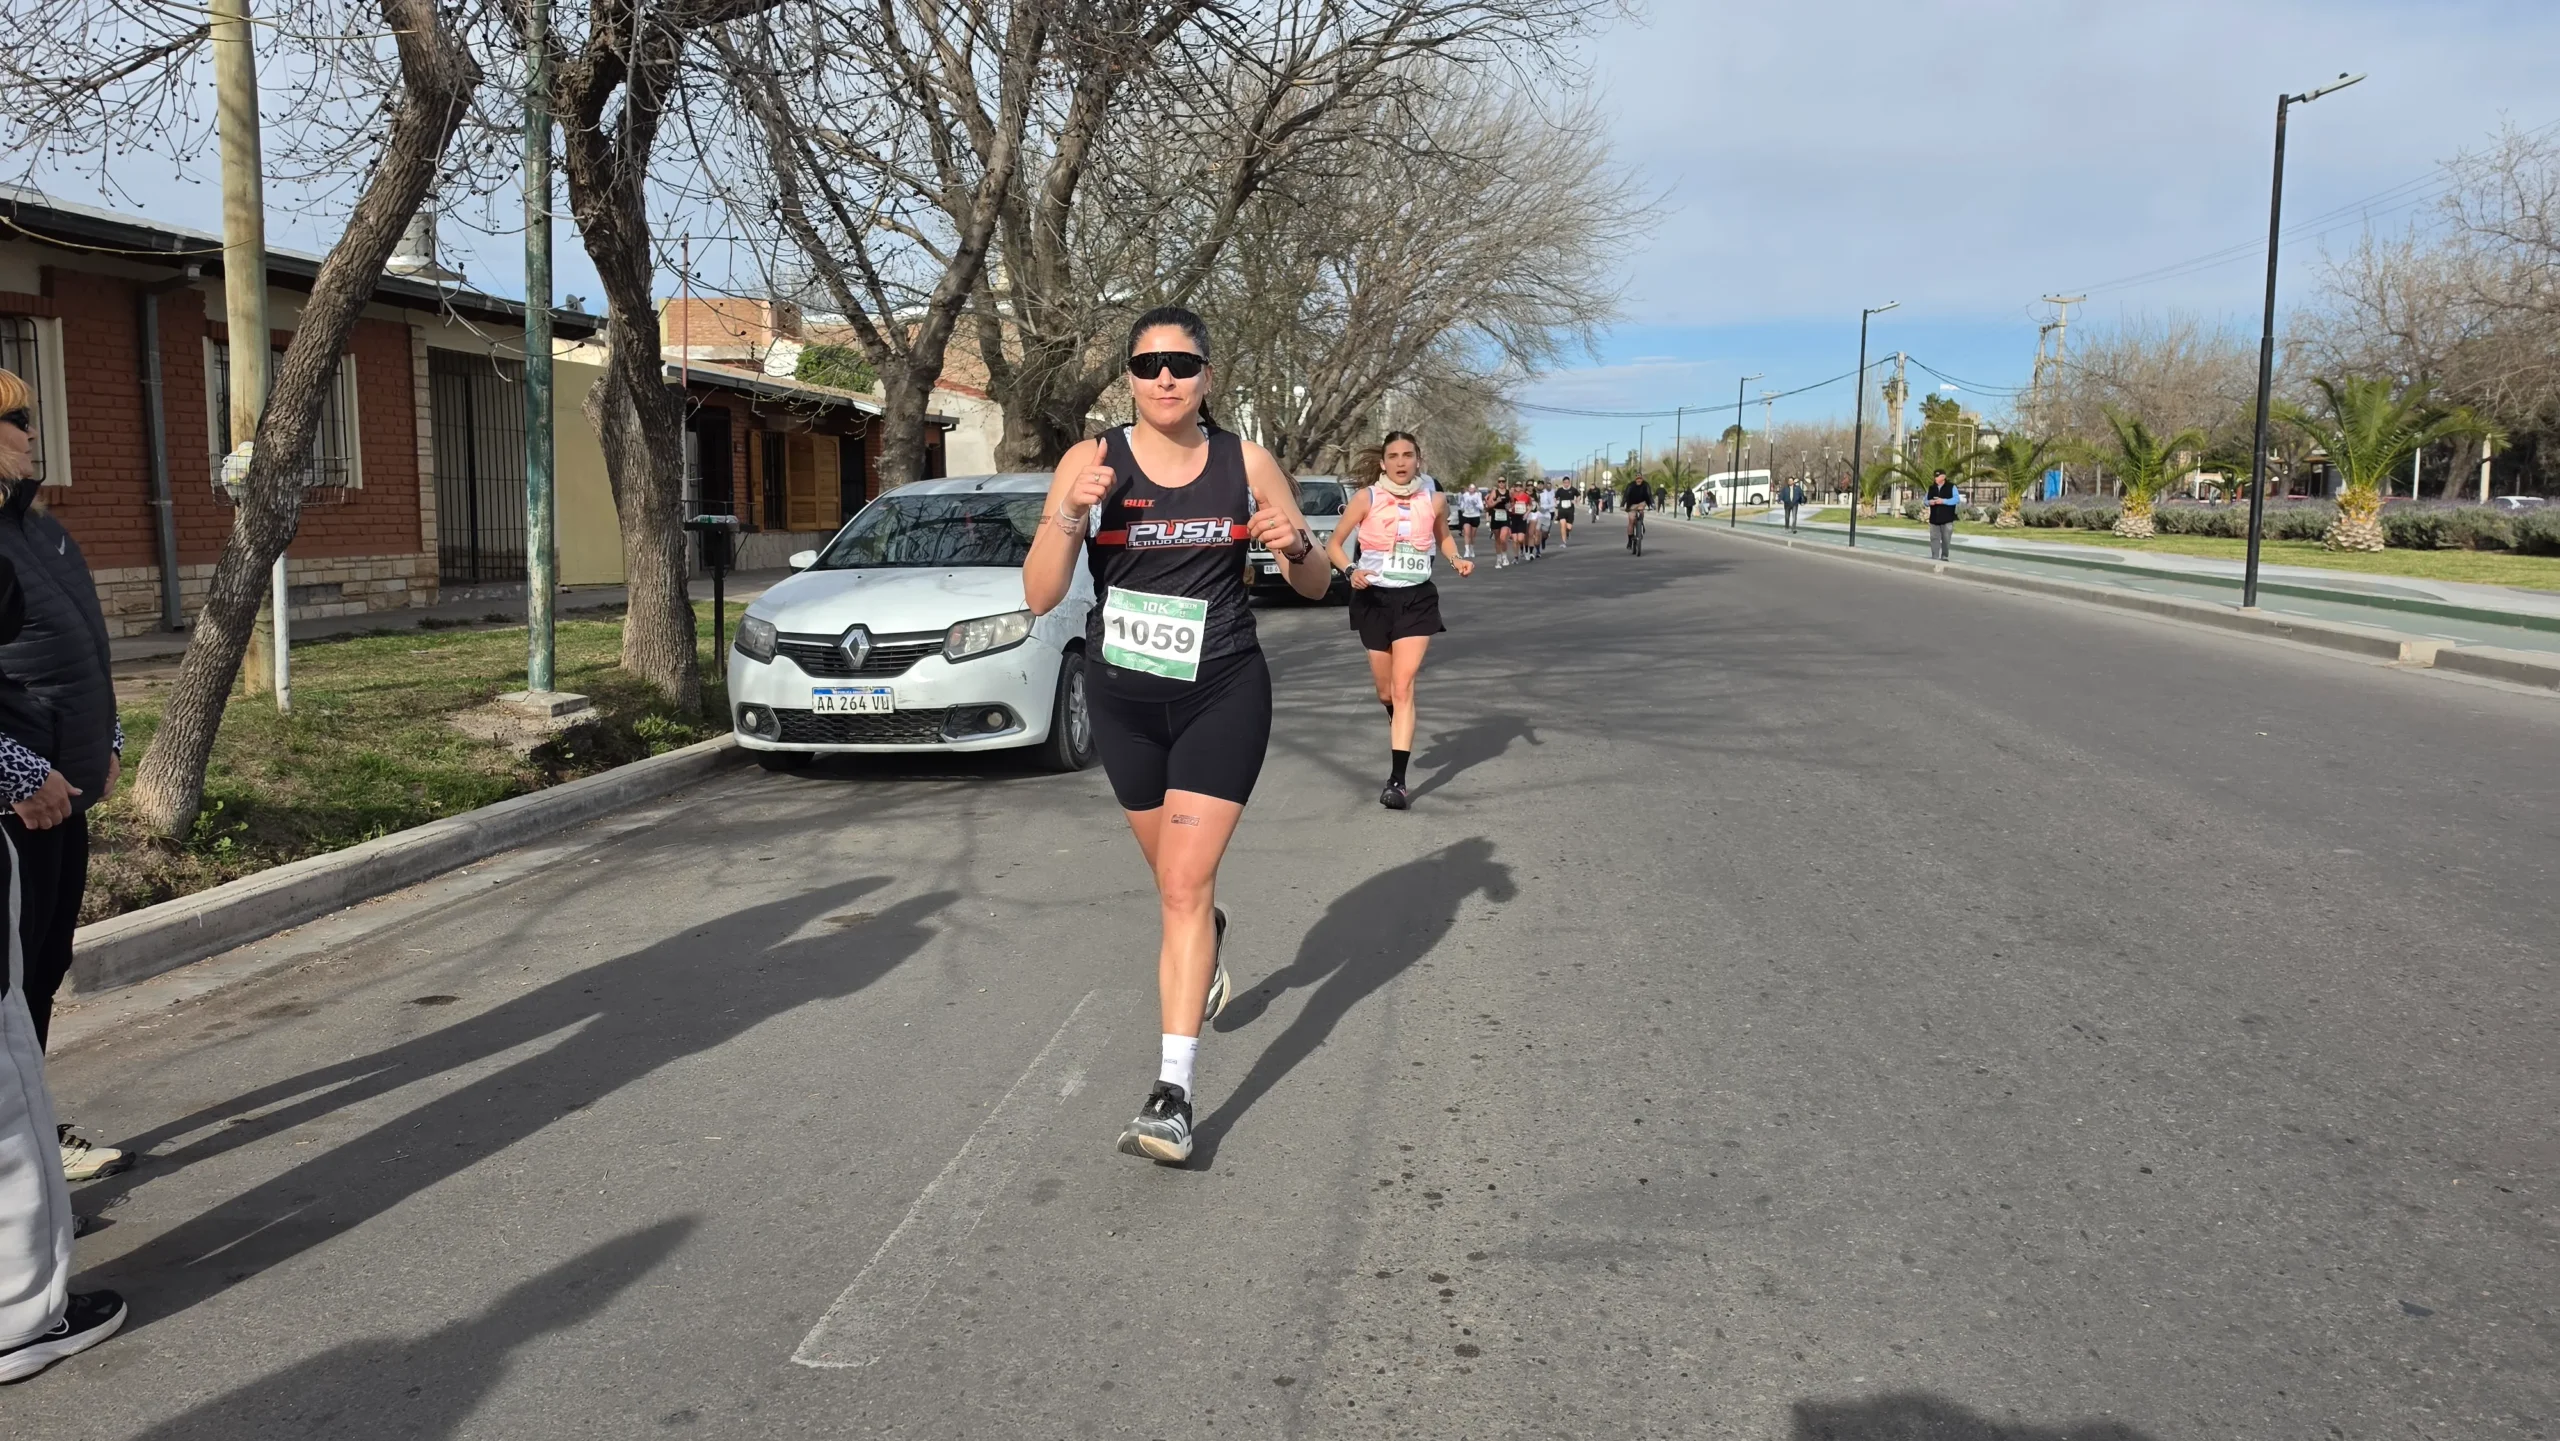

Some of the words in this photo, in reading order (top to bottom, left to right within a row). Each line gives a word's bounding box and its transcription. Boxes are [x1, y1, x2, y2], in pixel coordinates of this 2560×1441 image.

[1128, 520, 1231, 541] PUSH
[1174, 536, 1232, 545] DEPORTIVA
[1388, 555, 1425, 571] 1196
[1142, 601, 1170, 614] 10K
[1112, 616, 1195, 653] 1059
[817, 696, 835, 711] AA
[840, 696, 867, 711] 264
